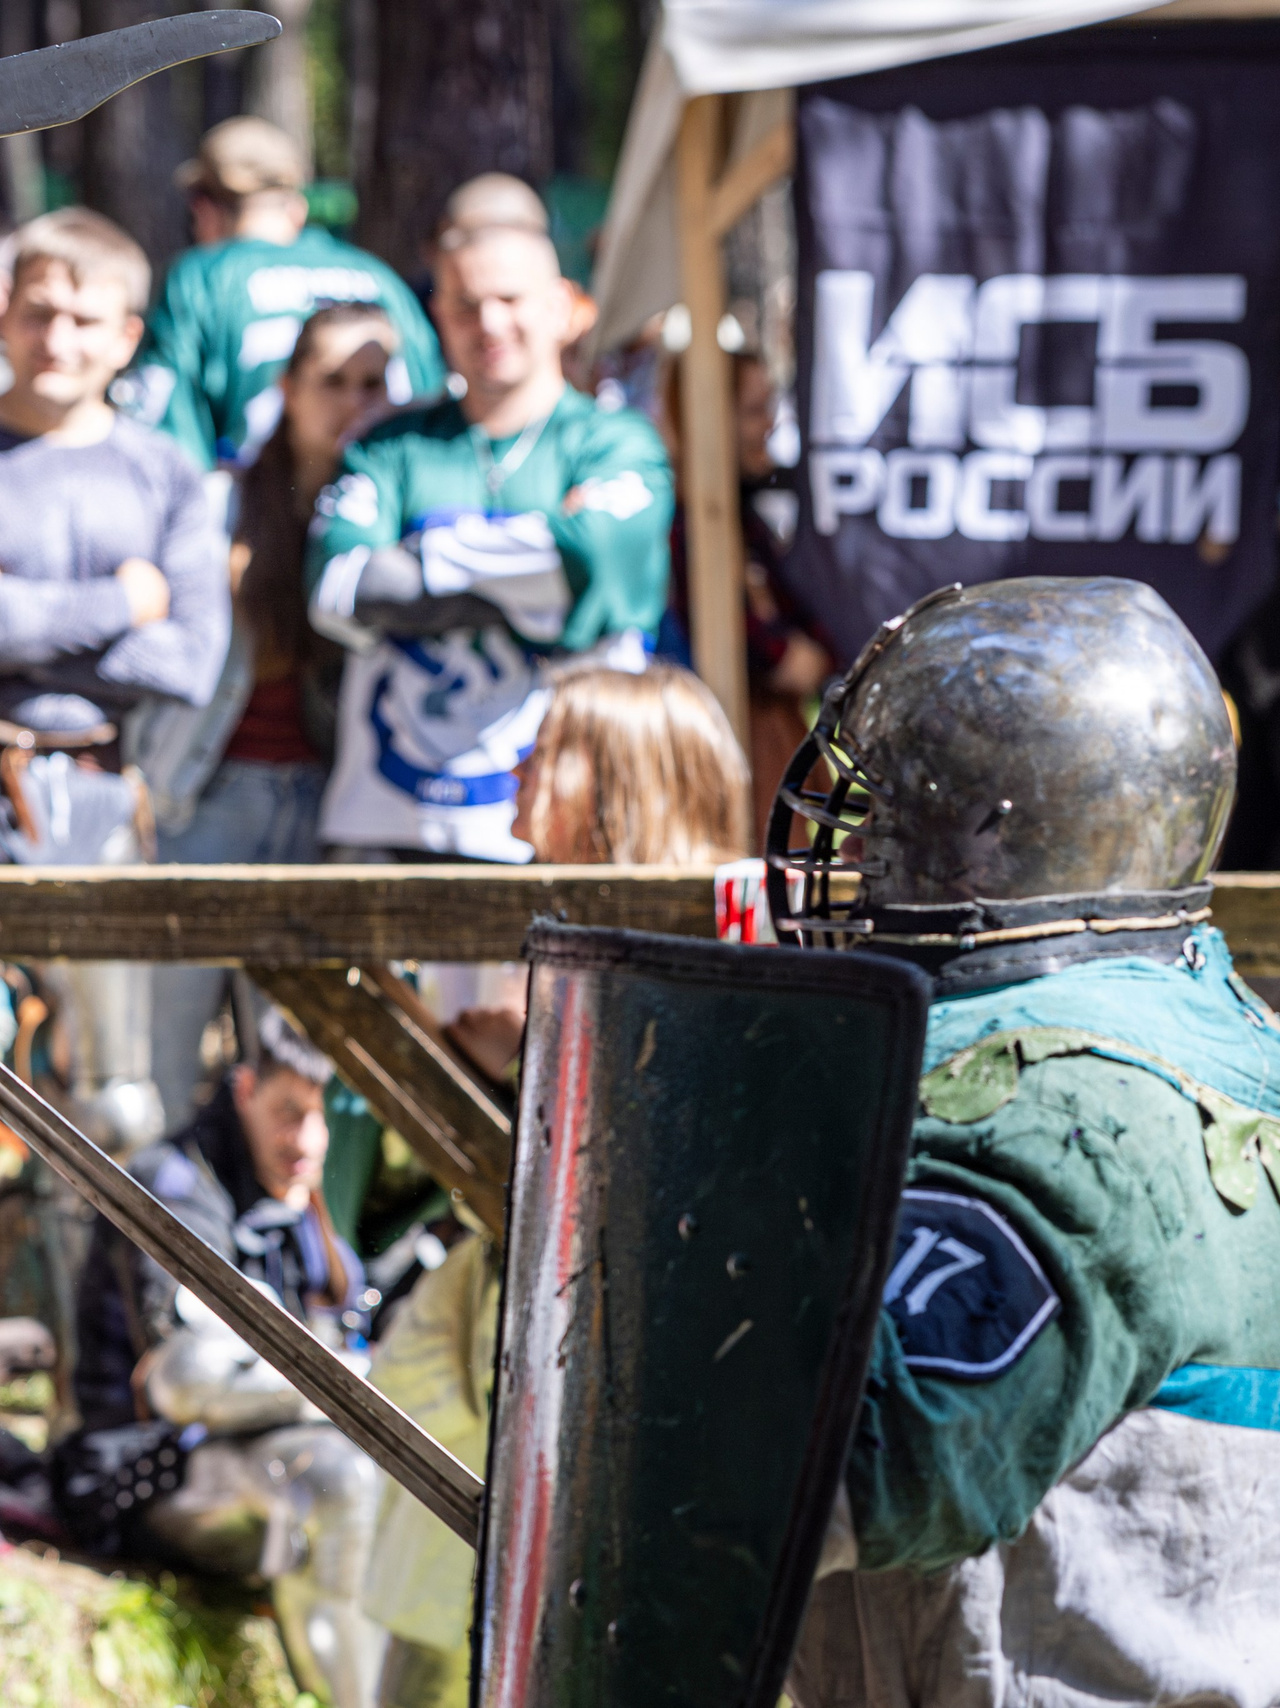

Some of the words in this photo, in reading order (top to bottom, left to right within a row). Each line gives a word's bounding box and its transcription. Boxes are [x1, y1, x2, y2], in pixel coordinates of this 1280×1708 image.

[810, 270, 1251, 453] ИСБ
[809, 447, 1243, 545] РОССИИ
[882, 1226, 986, 1316] 17
